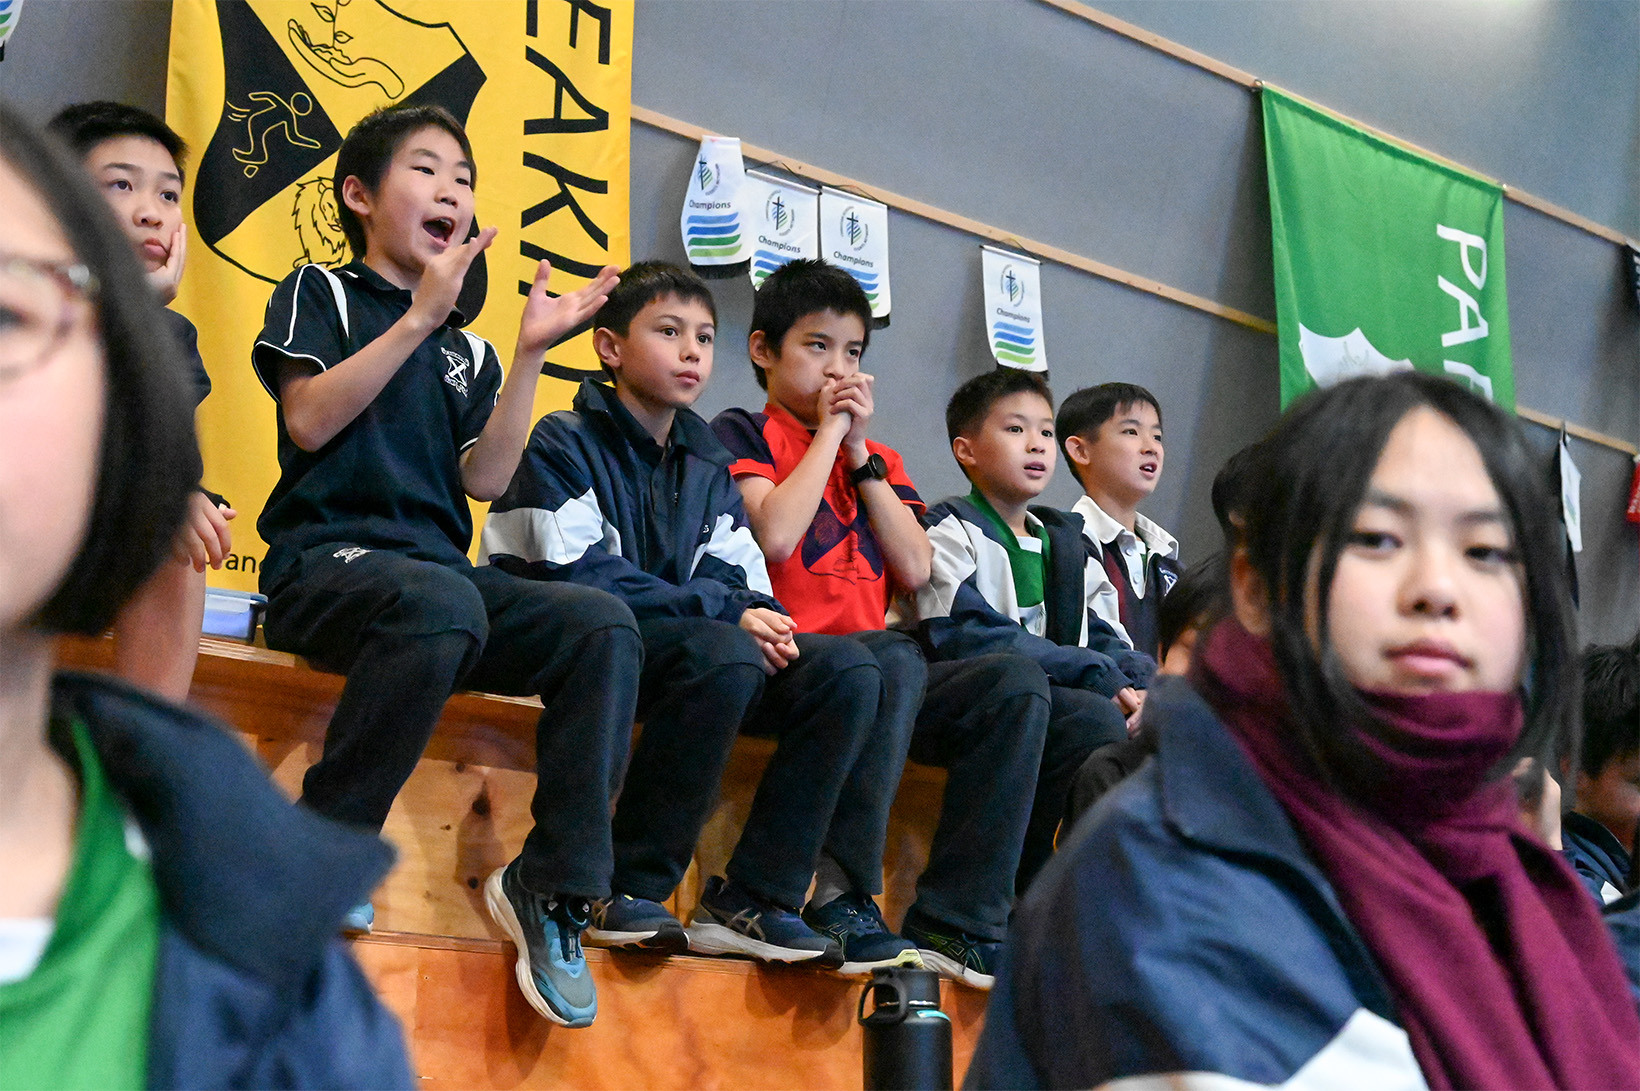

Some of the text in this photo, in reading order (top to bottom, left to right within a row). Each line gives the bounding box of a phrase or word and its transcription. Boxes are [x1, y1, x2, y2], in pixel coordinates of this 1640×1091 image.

[689, 199, 732, 211] Champions
[758, 235, 801, 253] Champions
[833, 250, 874, 268] Champions
